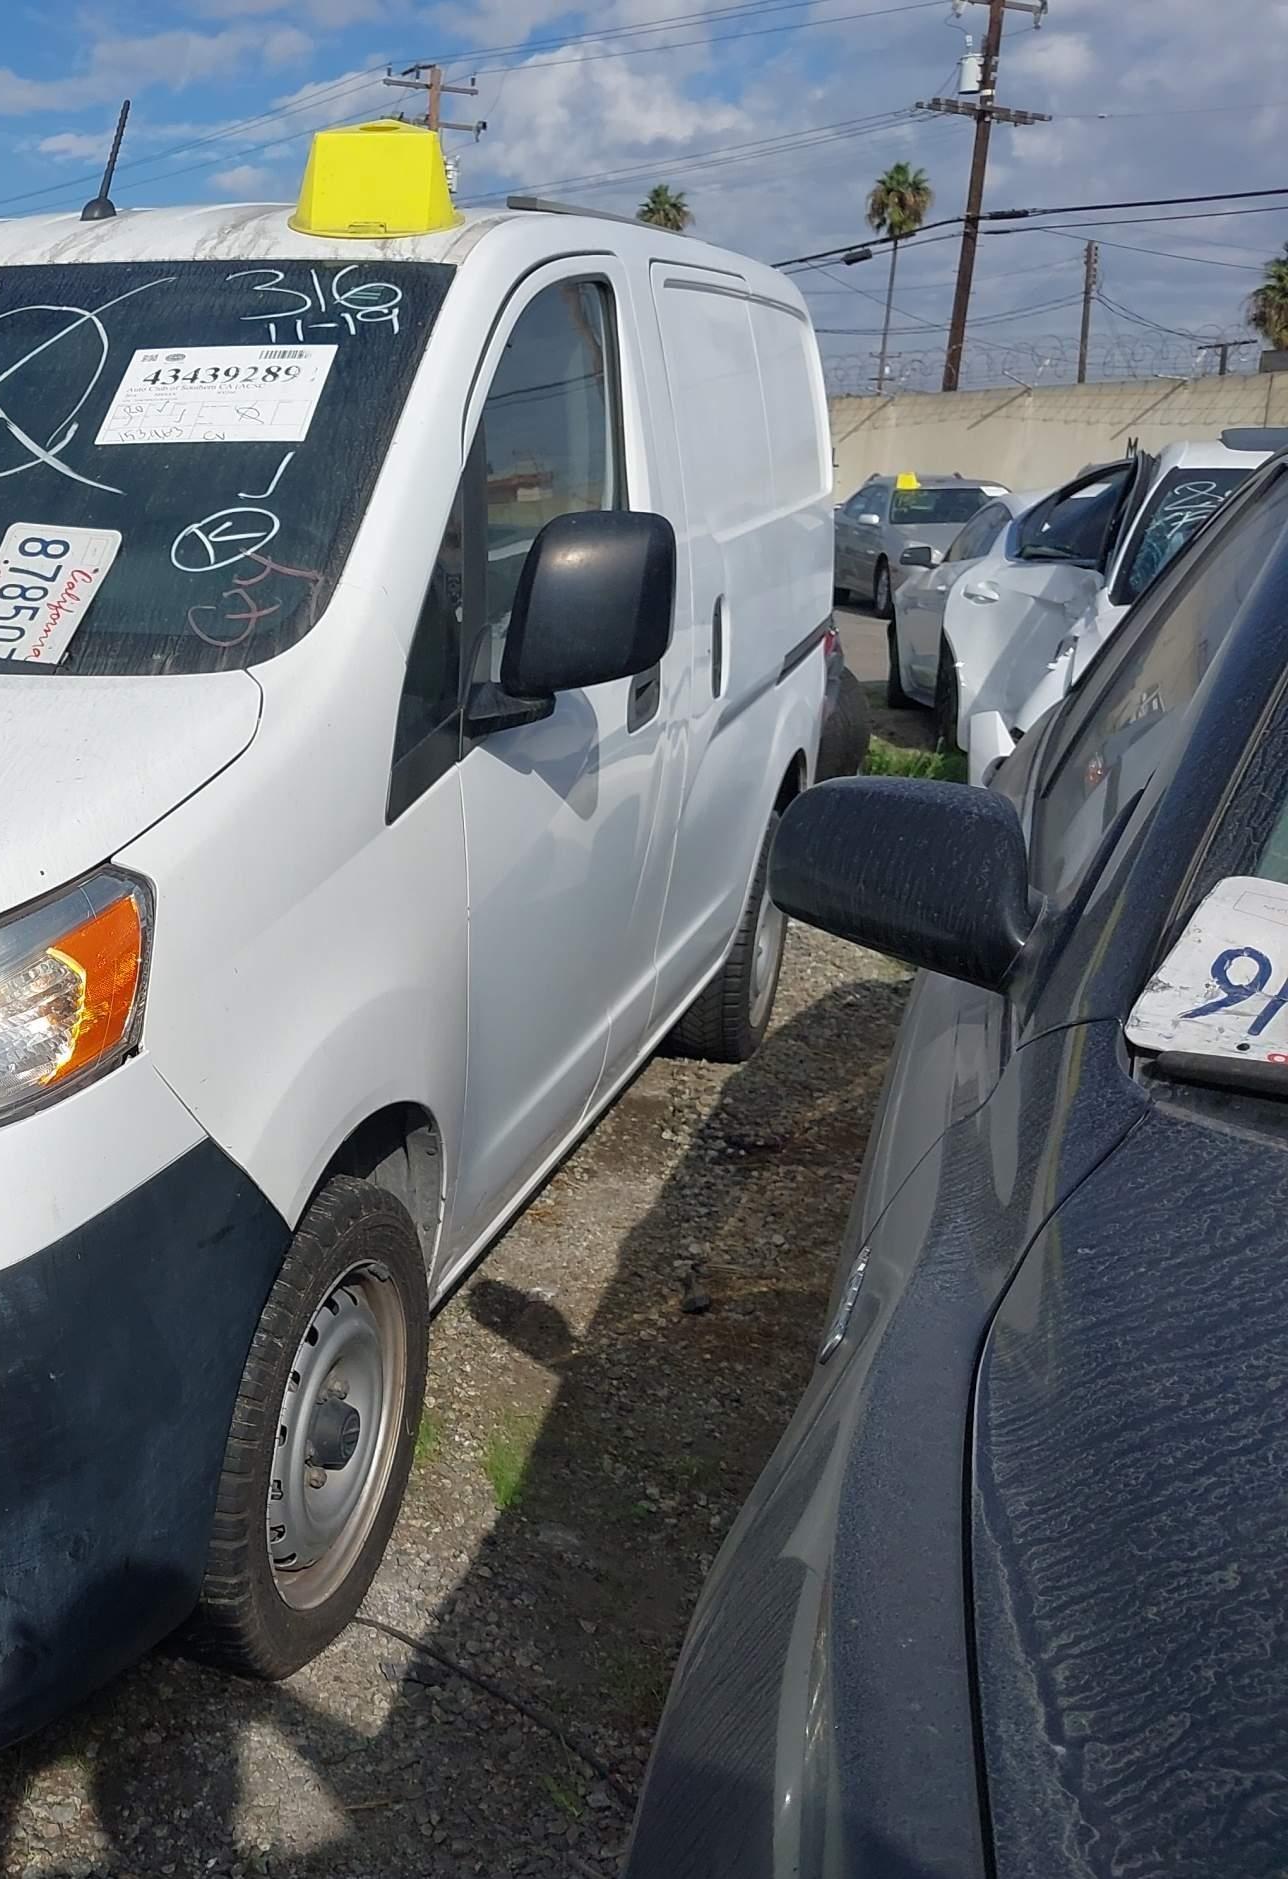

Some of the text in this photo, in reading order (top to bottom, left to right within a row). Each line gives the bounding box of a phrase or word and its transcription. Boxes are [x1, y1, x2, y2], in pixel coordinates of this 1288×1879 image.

[225, 265, 402, 320] 316
[269, 307, 399, 343] 11-19
[143, 365, 301, 385] 43439289
